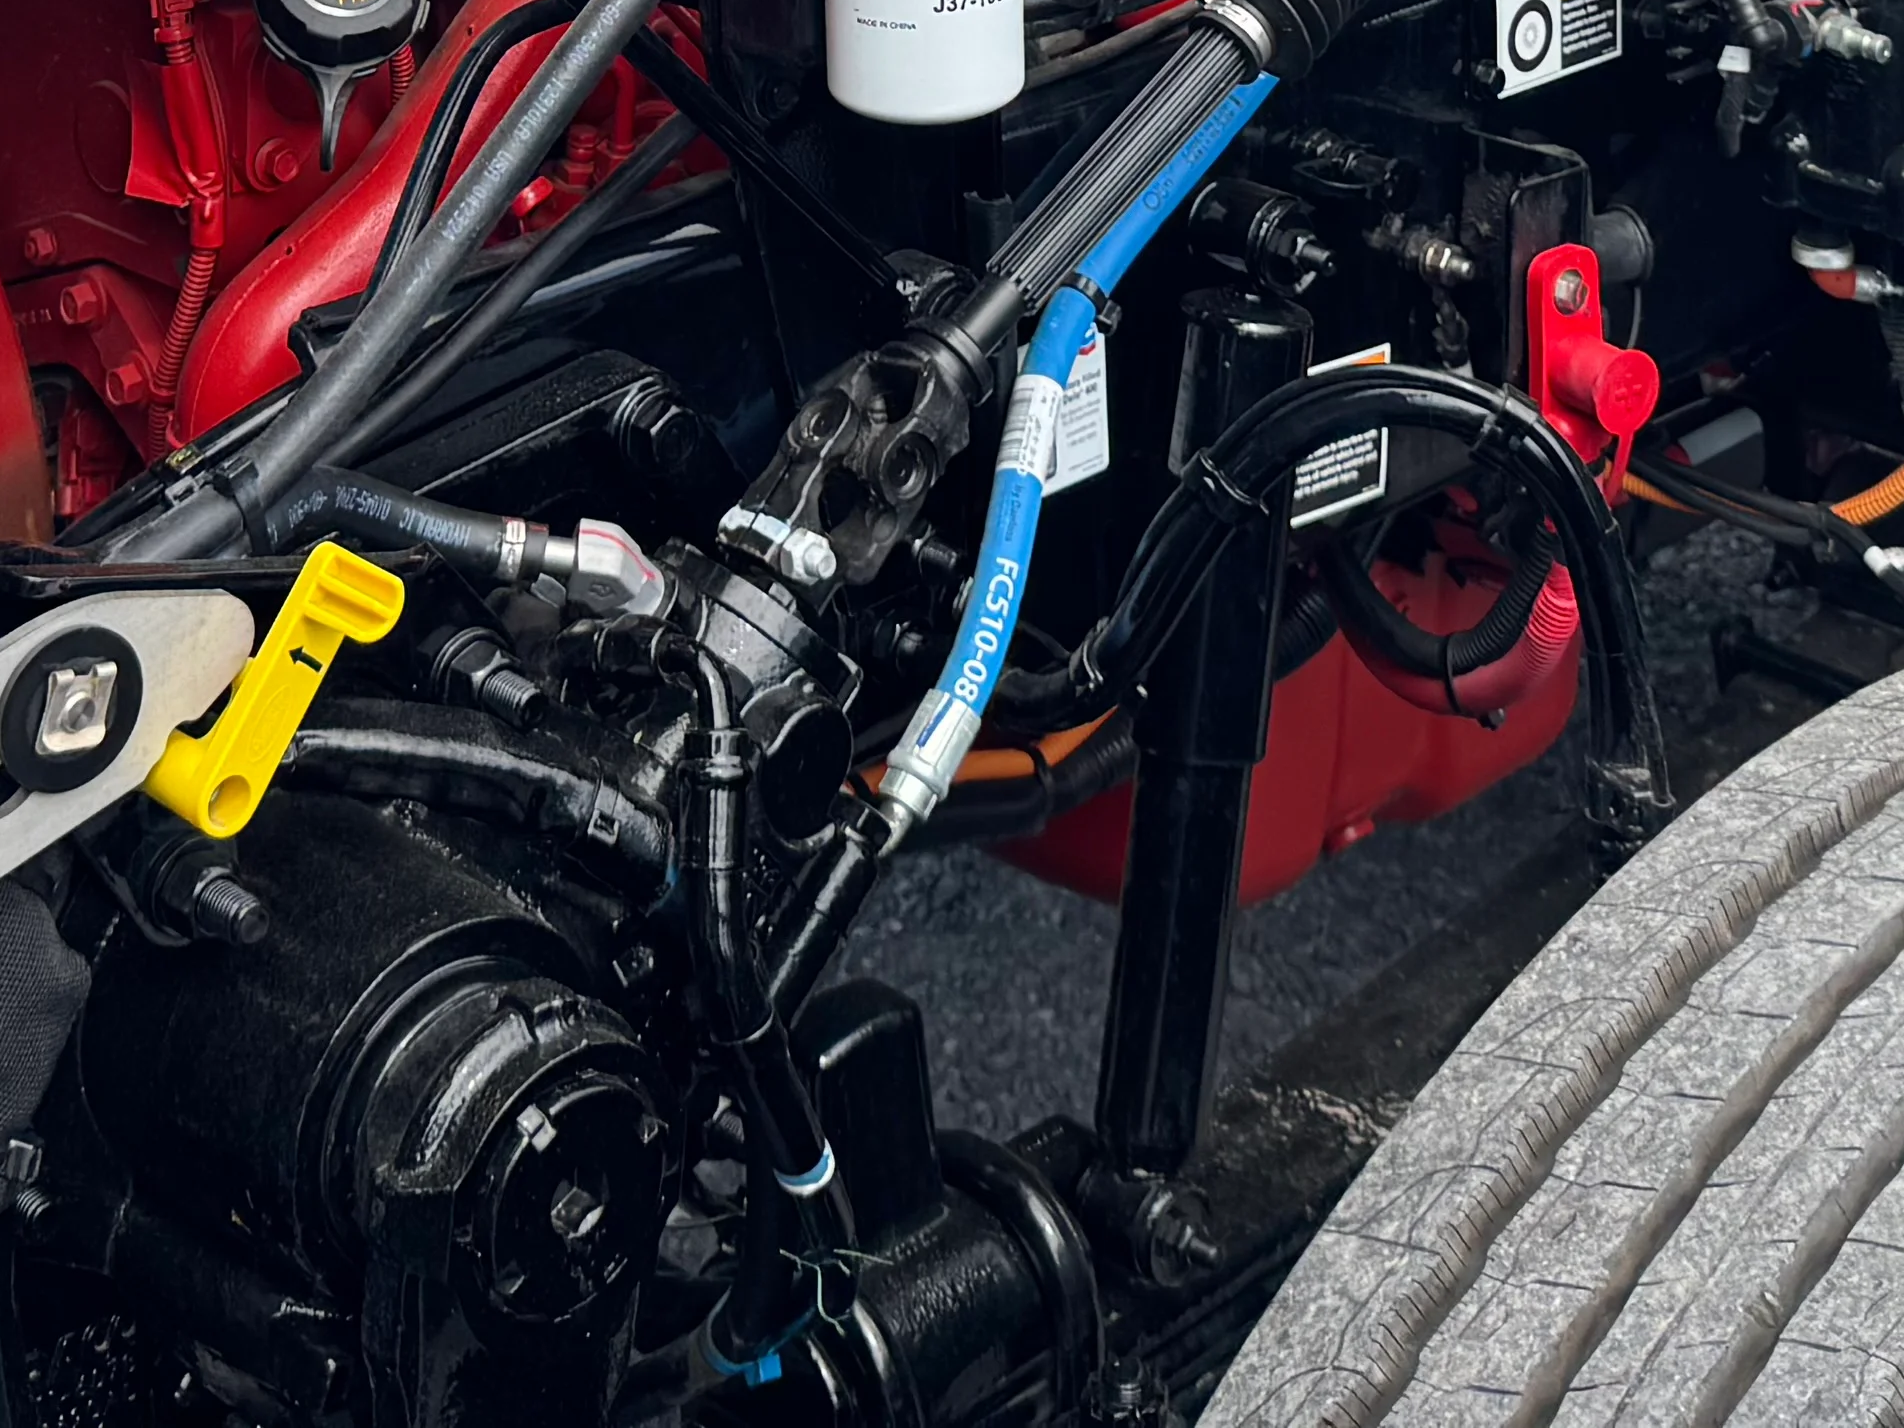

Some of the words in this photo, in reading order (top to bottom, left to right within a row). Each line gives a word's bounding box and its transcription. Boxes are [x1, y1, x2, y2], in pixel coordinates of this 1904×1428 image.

[484, 149, 514, 183] USA
[399, 506, 473, 548] HYDRAULIC
[953, 555, 1021, 702] FC510-08
